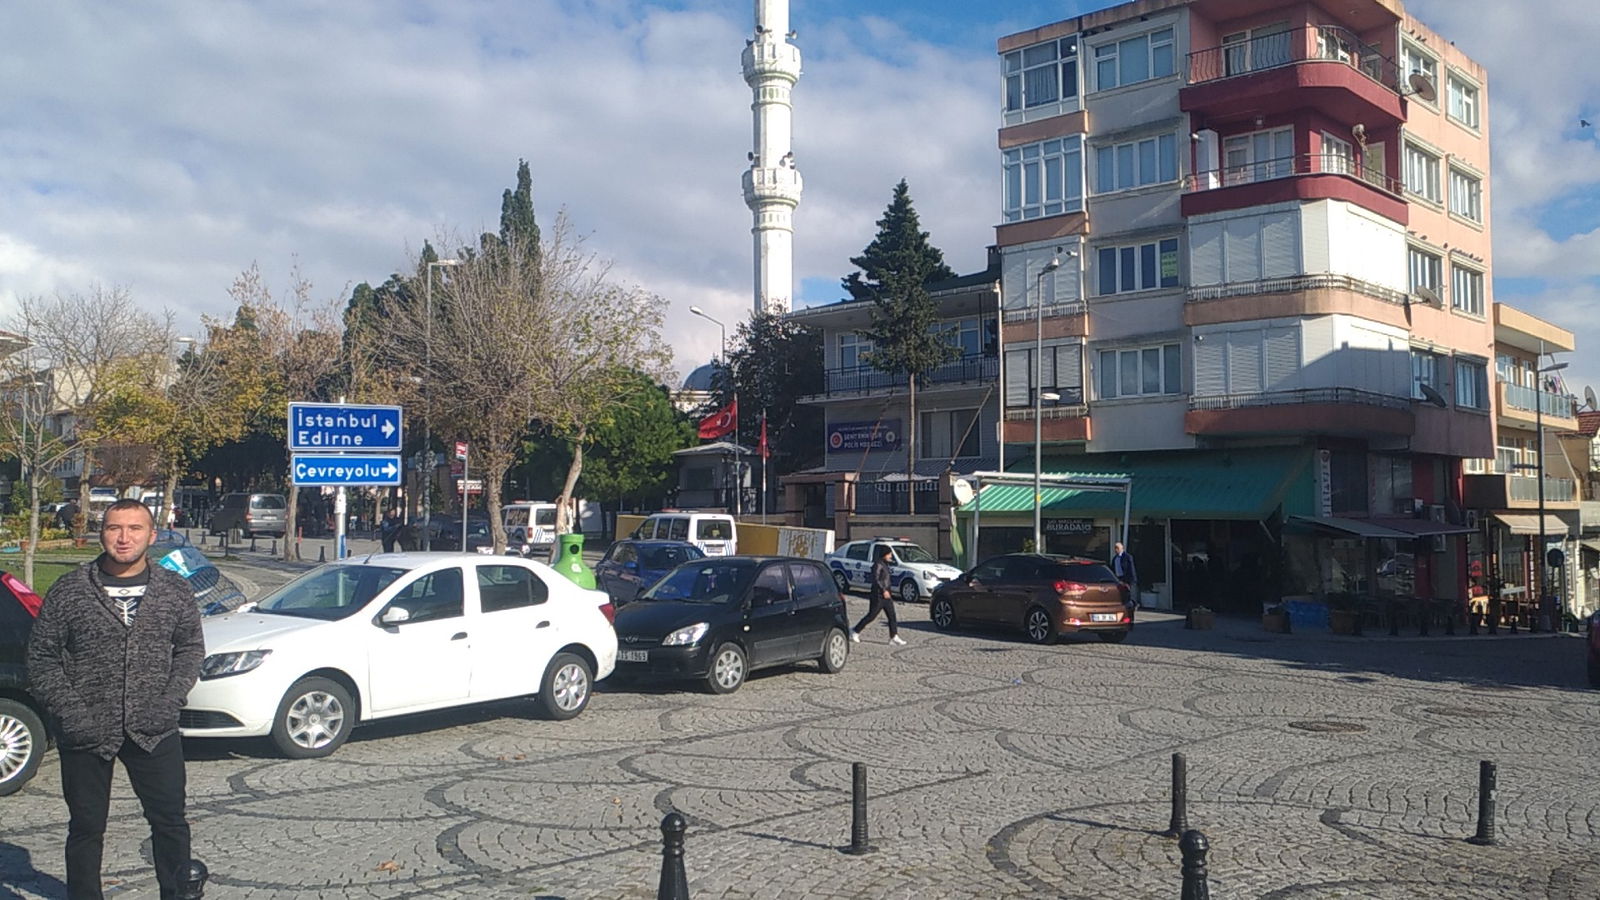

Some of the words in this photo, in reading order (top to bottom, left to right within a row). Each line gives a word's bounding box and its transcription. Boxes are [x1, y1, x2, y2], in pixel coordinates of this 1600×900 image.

[298, 409, 377, 428] İstanbul
[298, 431, 364, 446] Edirne
[296, 462, 380, 480] Çevreyolu
